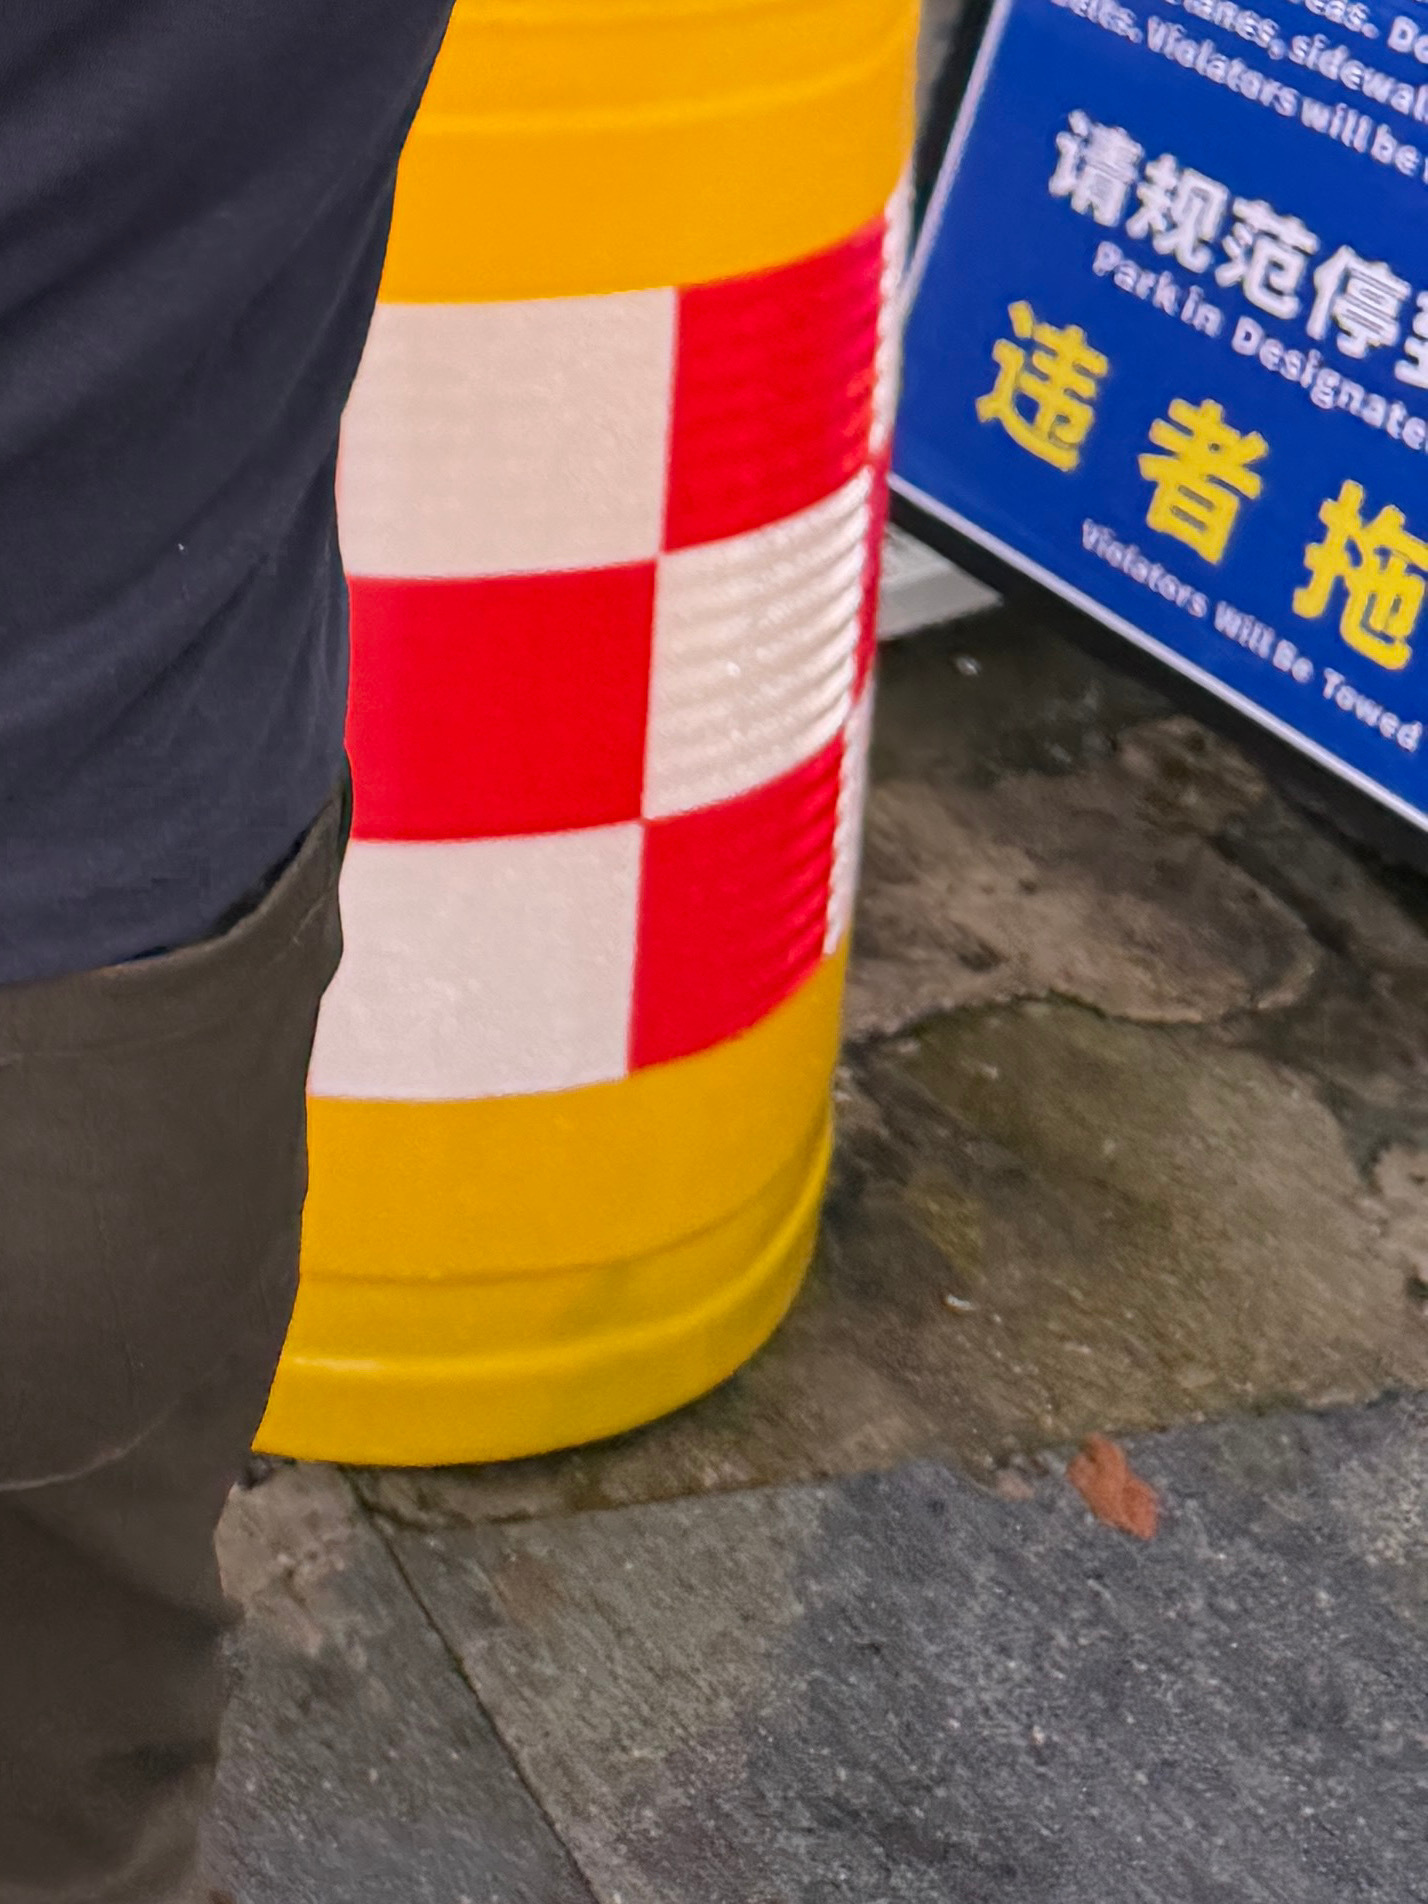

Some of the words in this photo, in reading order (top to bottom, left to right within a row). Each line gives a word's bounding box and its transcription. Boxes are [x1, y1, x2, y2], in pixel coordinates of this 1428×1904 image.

[1147, 15, 1298, 117] Violators
[1288, 33, 1428, 124] sidewal
[1092, 240, 1178, 317] Park
[1231, 315, 1428, 454] Designate
[1081, 518, 1209, 619] Violators
[1322, 667, 1423, 753] Towed
